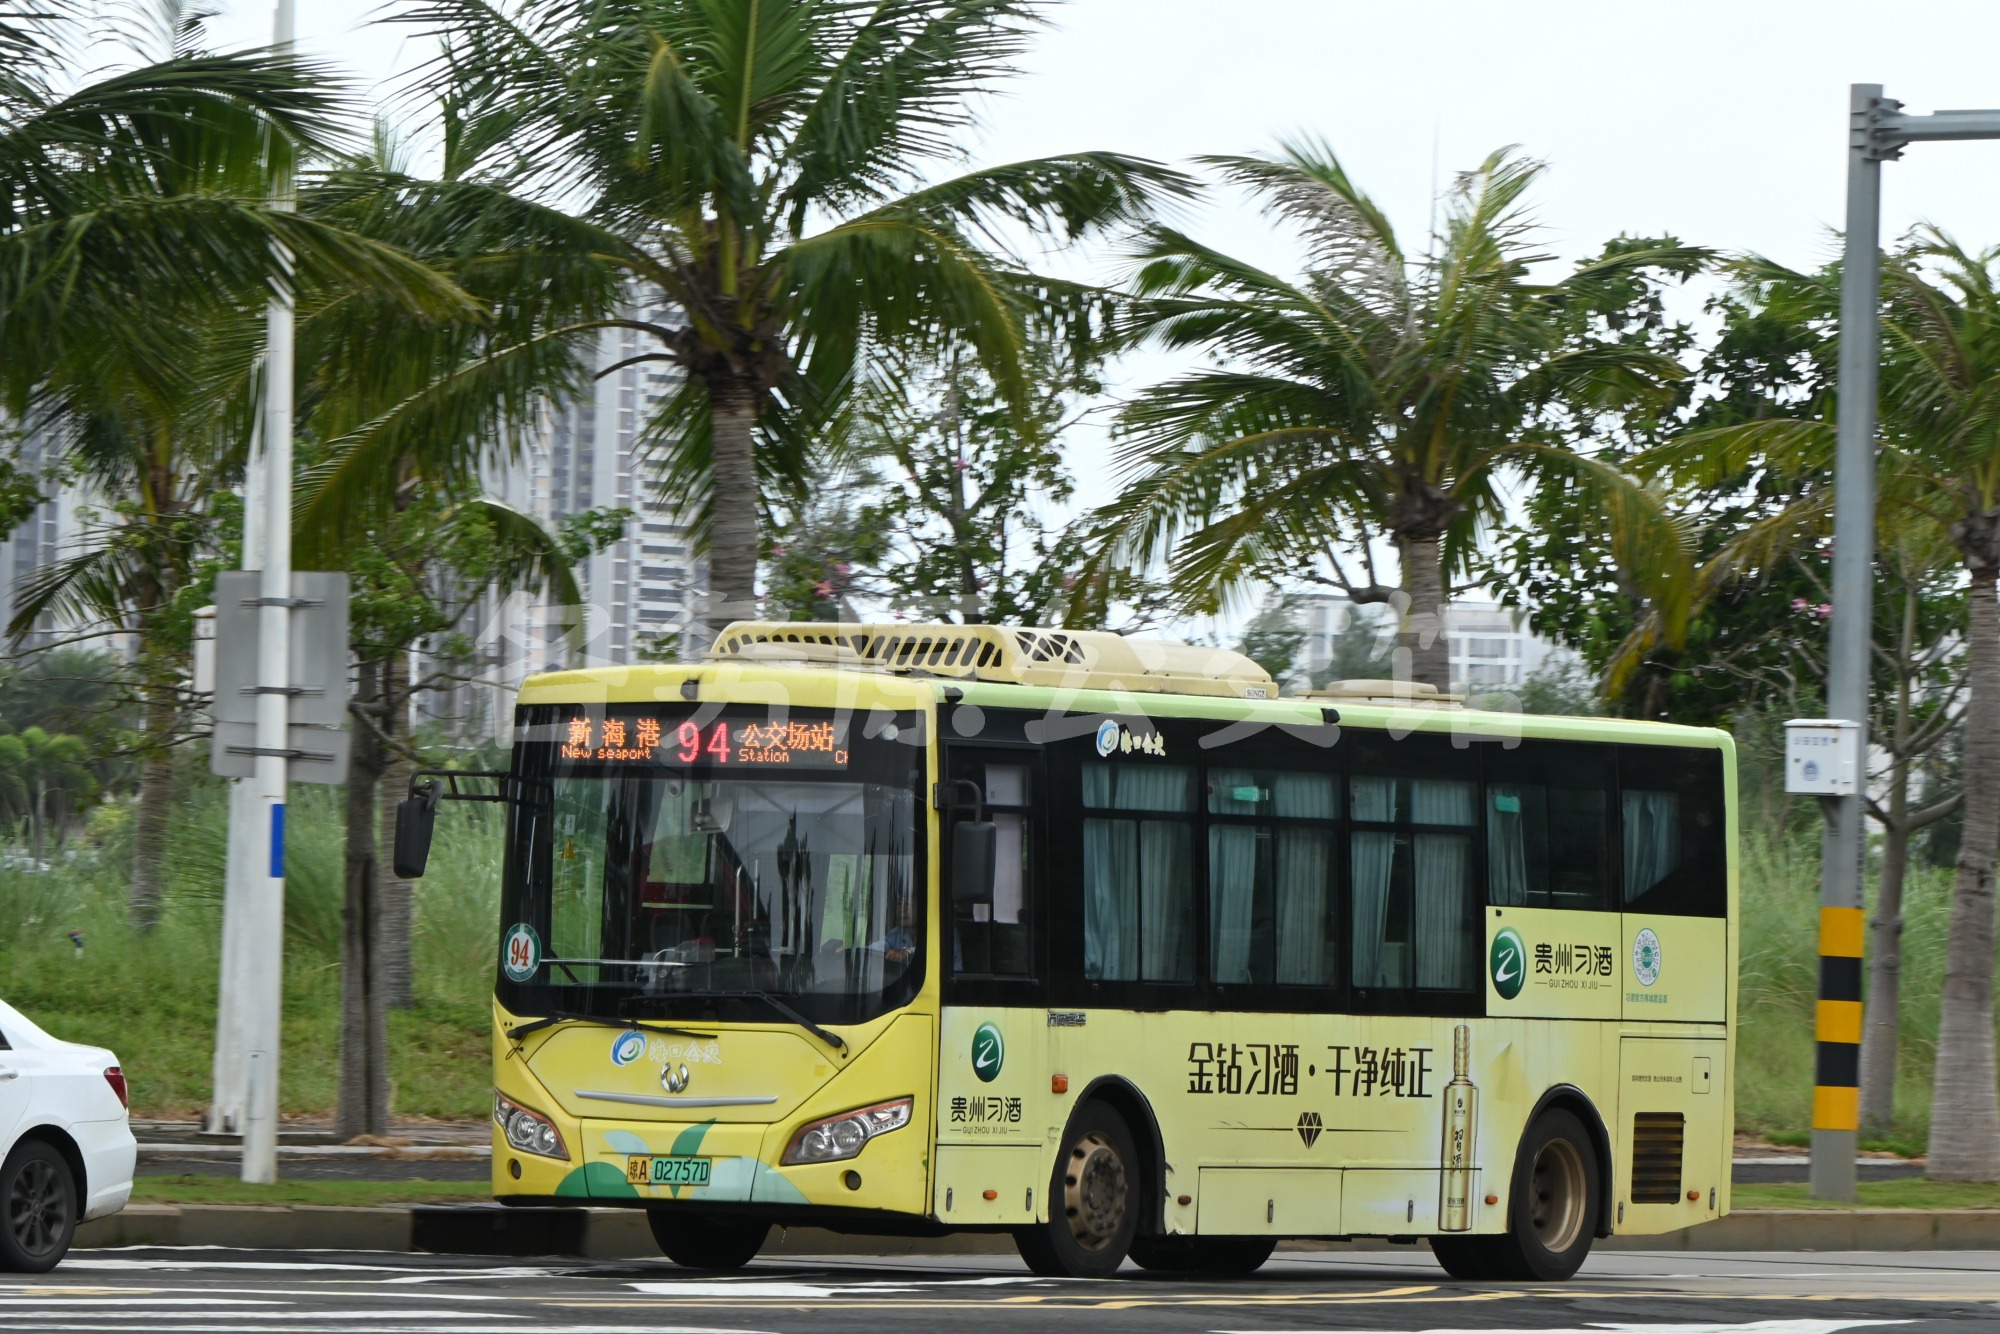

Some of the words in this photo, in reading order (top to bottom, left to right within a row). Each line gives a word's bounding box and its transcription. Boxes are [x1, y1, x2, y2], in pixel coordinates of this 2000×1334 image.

[1246, 688, 1265, 698] SONGZ
[567, 717, 661, 748] 新海港
[678, 721, 731, 763] 94
[740, 721, 834, 752] 公交场站
[561, 745, 592, 759] New
[597, 747, 652, 761] seaport
[739, 749, 790, 763] Station
[511, 937, 529, 967] 94
[1534, 942, 1612, 976] 贵州习酒
[648, 1038, 722, 1065] 海口公交
[950, 1096, 1022, 1123] 贵州习酒
